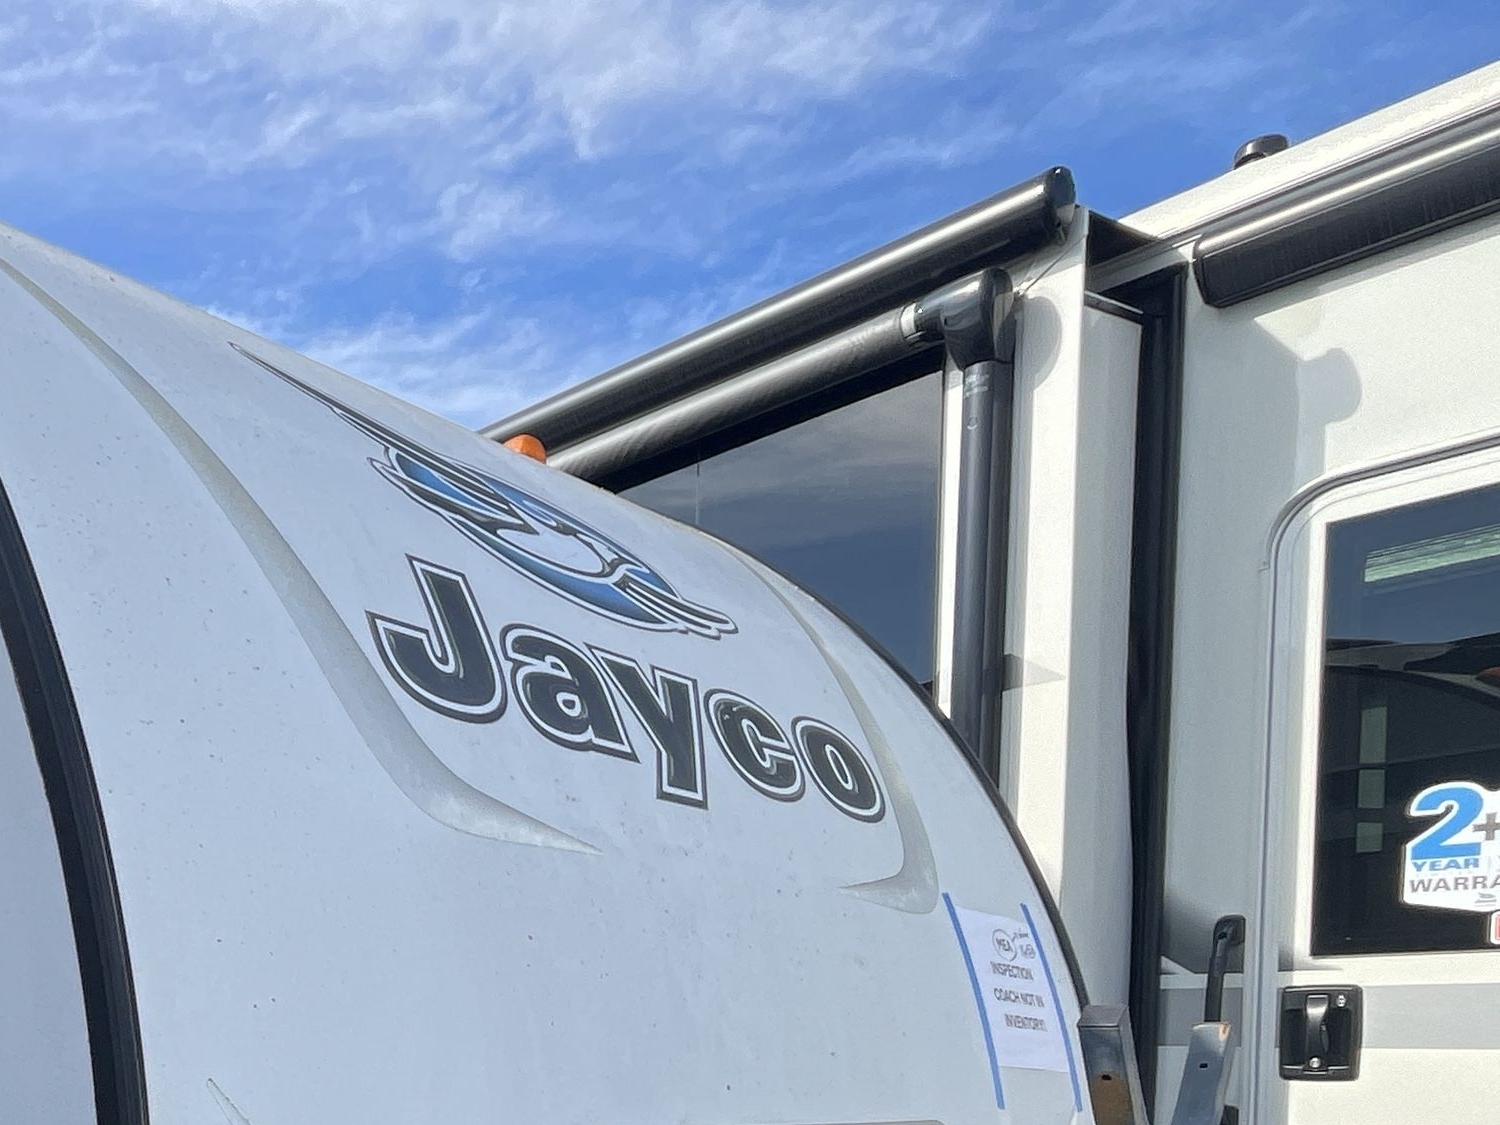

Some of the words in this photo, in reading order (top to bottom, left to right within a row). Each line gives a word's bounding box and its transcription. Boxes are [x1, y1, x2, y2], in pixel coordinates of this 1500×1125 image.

[365, 554, 886, 823] Jayco
[1411, 858, 1480, 872] YEAR
[990, 961, 1034, 980] INSPECTION
[993, 987, 1020, 1003] COACH
